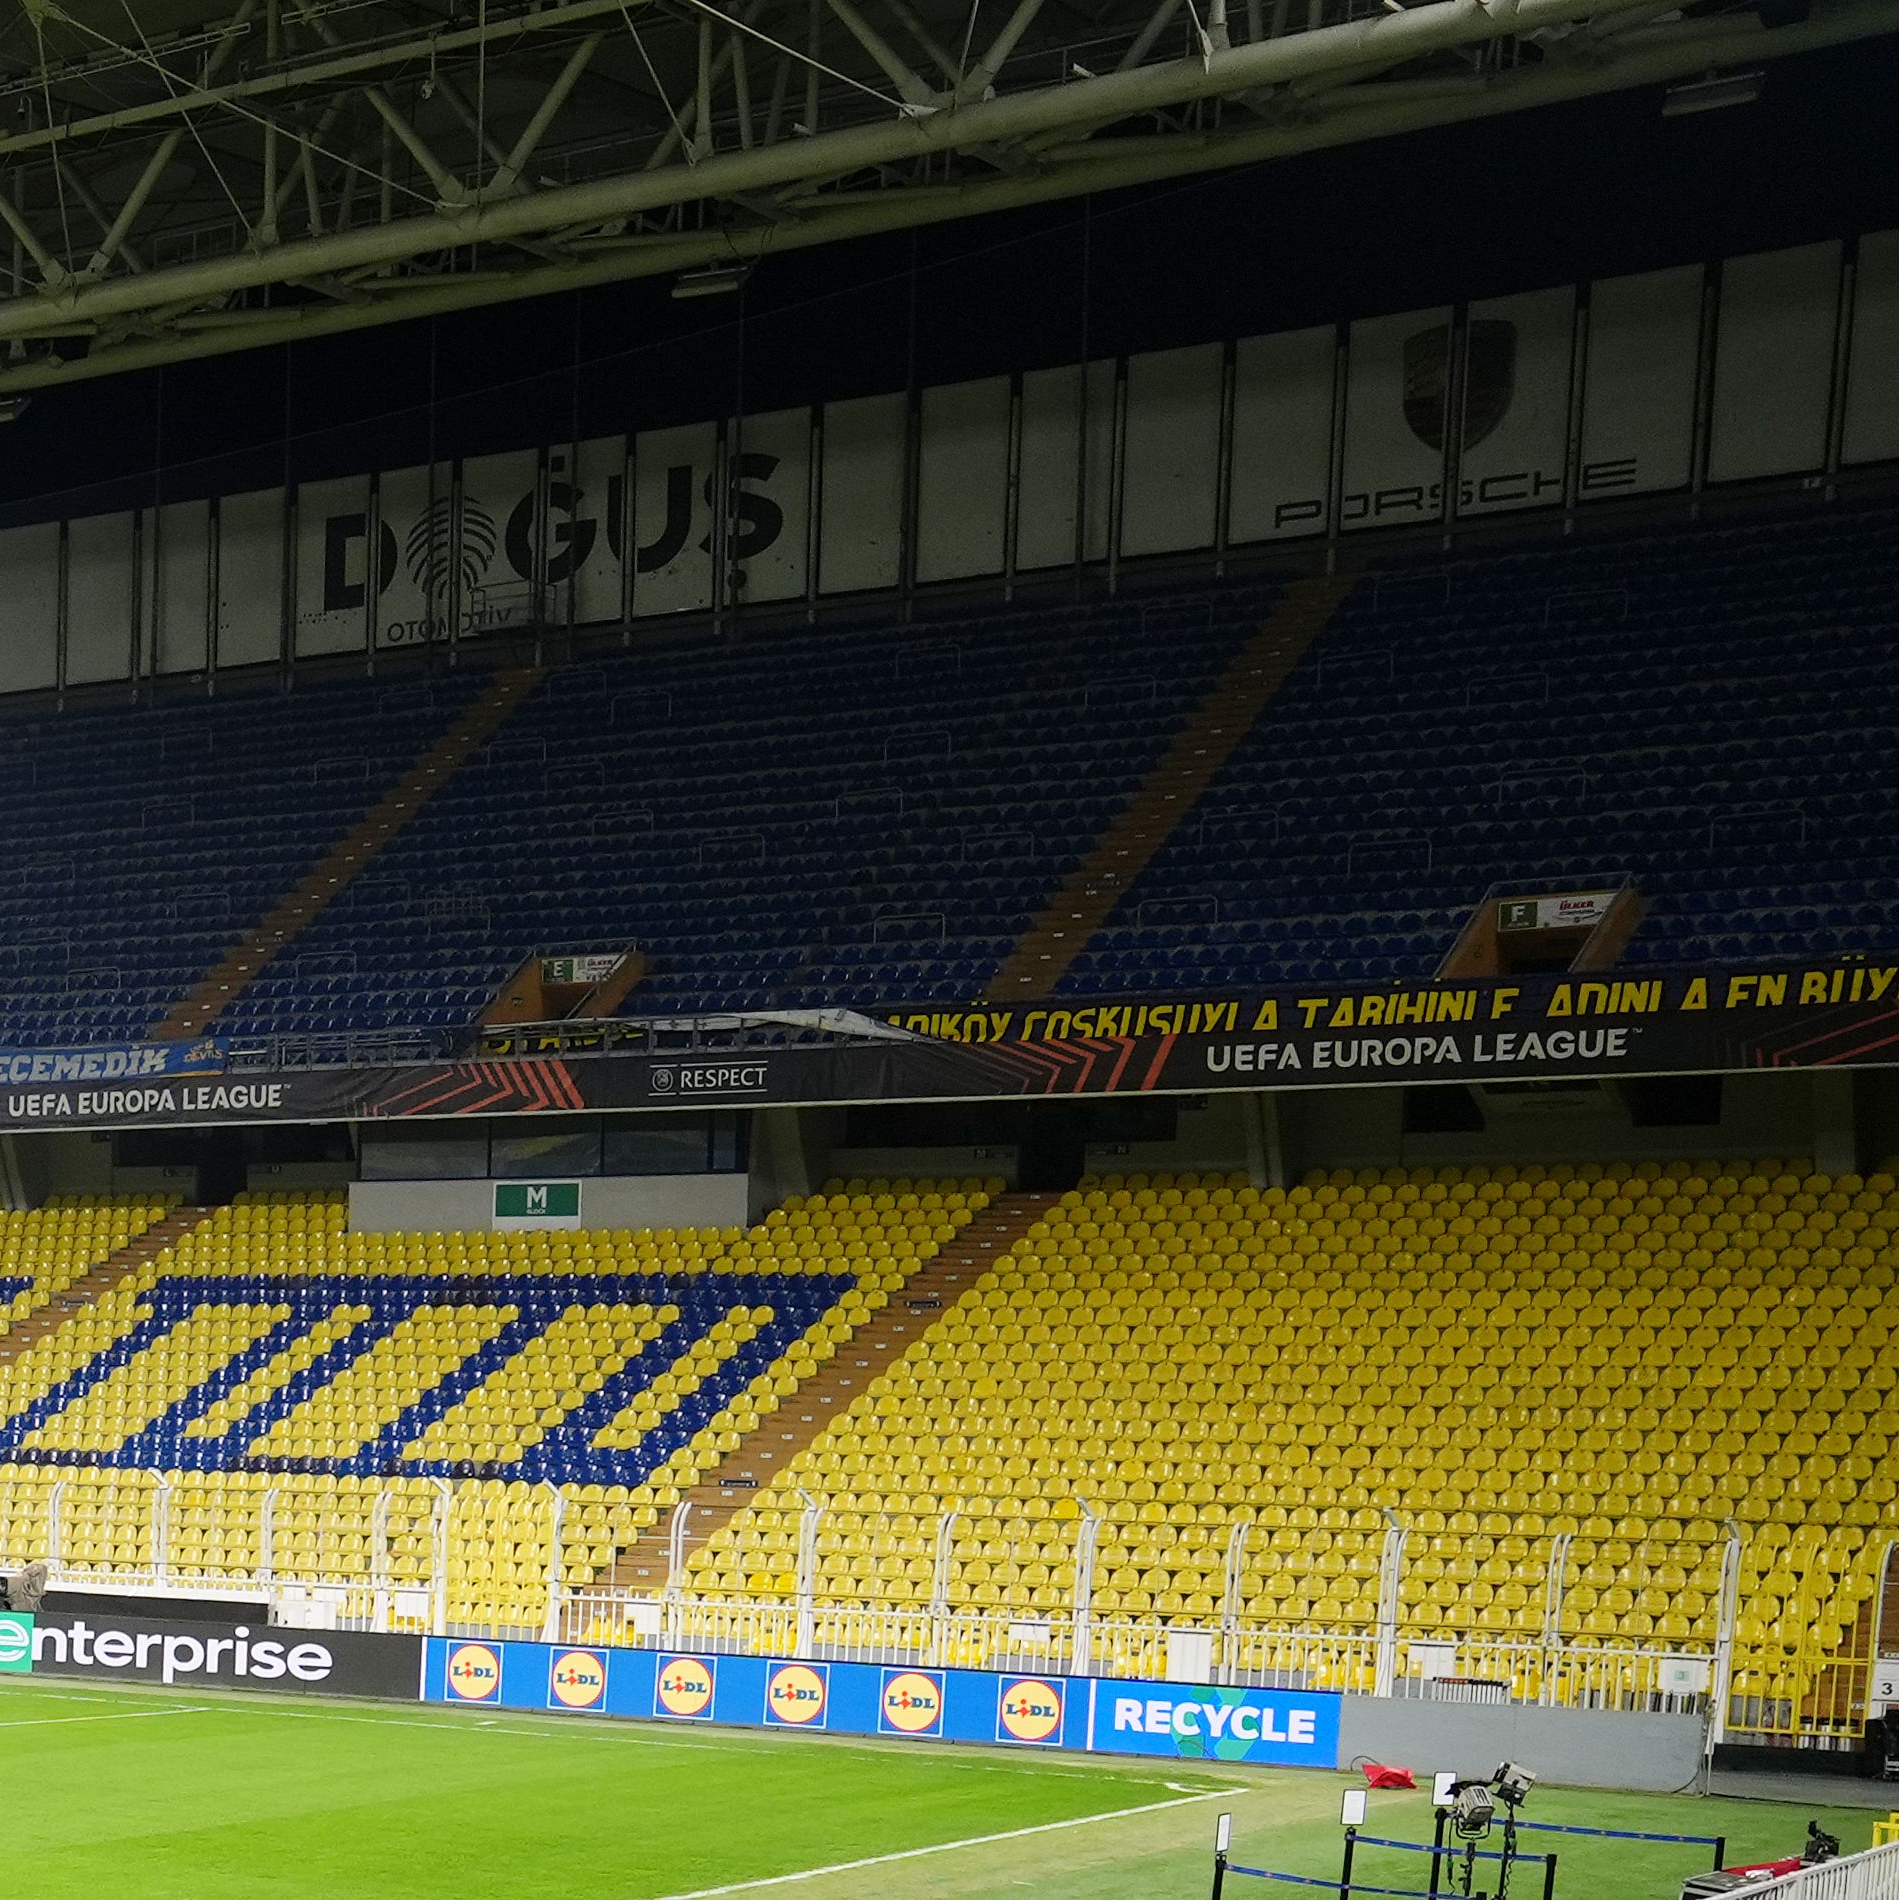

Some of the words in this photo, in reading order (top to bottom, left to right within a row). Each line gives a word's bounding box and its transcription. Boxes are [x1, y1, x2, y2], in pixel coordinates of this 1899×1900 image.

[1206, 1042, 1302, 1073] UEFA
[1313, 1033, 1462, 1069] EUROPA
[679, 1065, 768, 1092] RESPECT
[7, 1090, 71, 1118] UEFA
[78, 1086, 177, 1116] EUROPA
[182, 1082, 283, 1111] LEAGUE
[526, 1186, 548, 1209] M
[1113, 1697, 1316, 1744] RECYCLE
